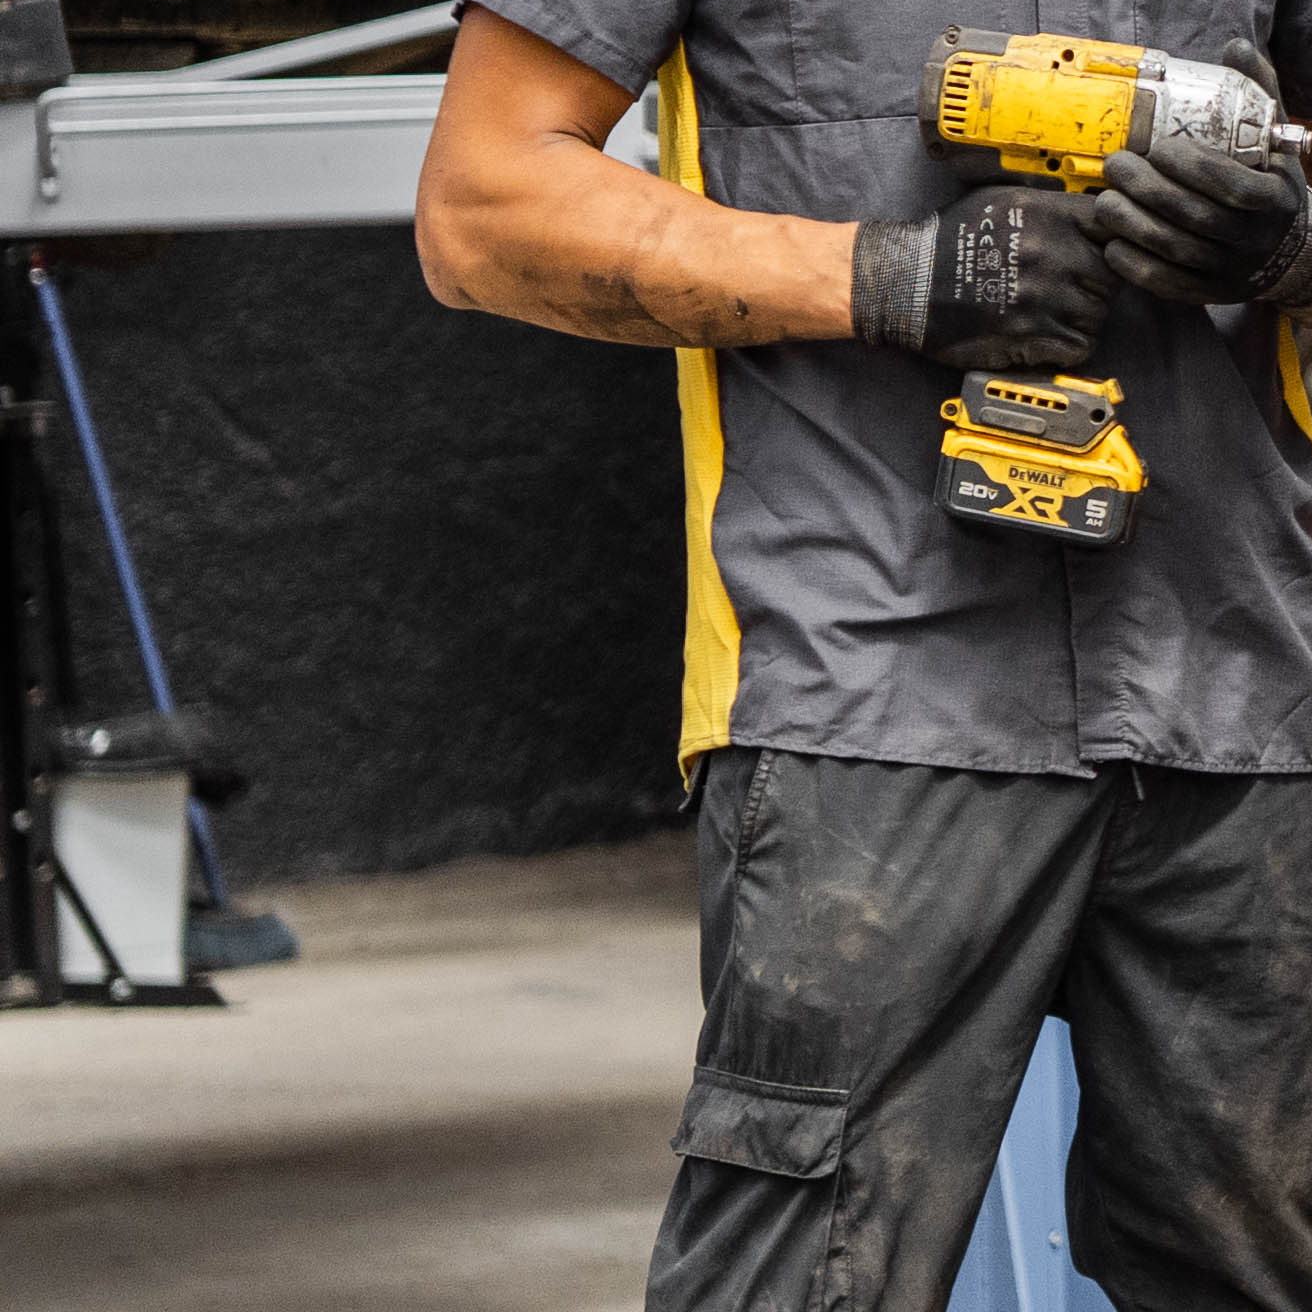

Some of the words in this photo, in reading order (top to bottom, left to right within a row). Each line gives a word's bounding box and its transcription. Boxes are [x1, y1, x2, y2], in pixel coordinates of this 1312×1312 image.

[966, 249, 976, 284] BLACK
[988, 484, 1069, 528] XR
[1085, 499, 1109, 519] 5
[1085, 518, 1104, 528] AH
